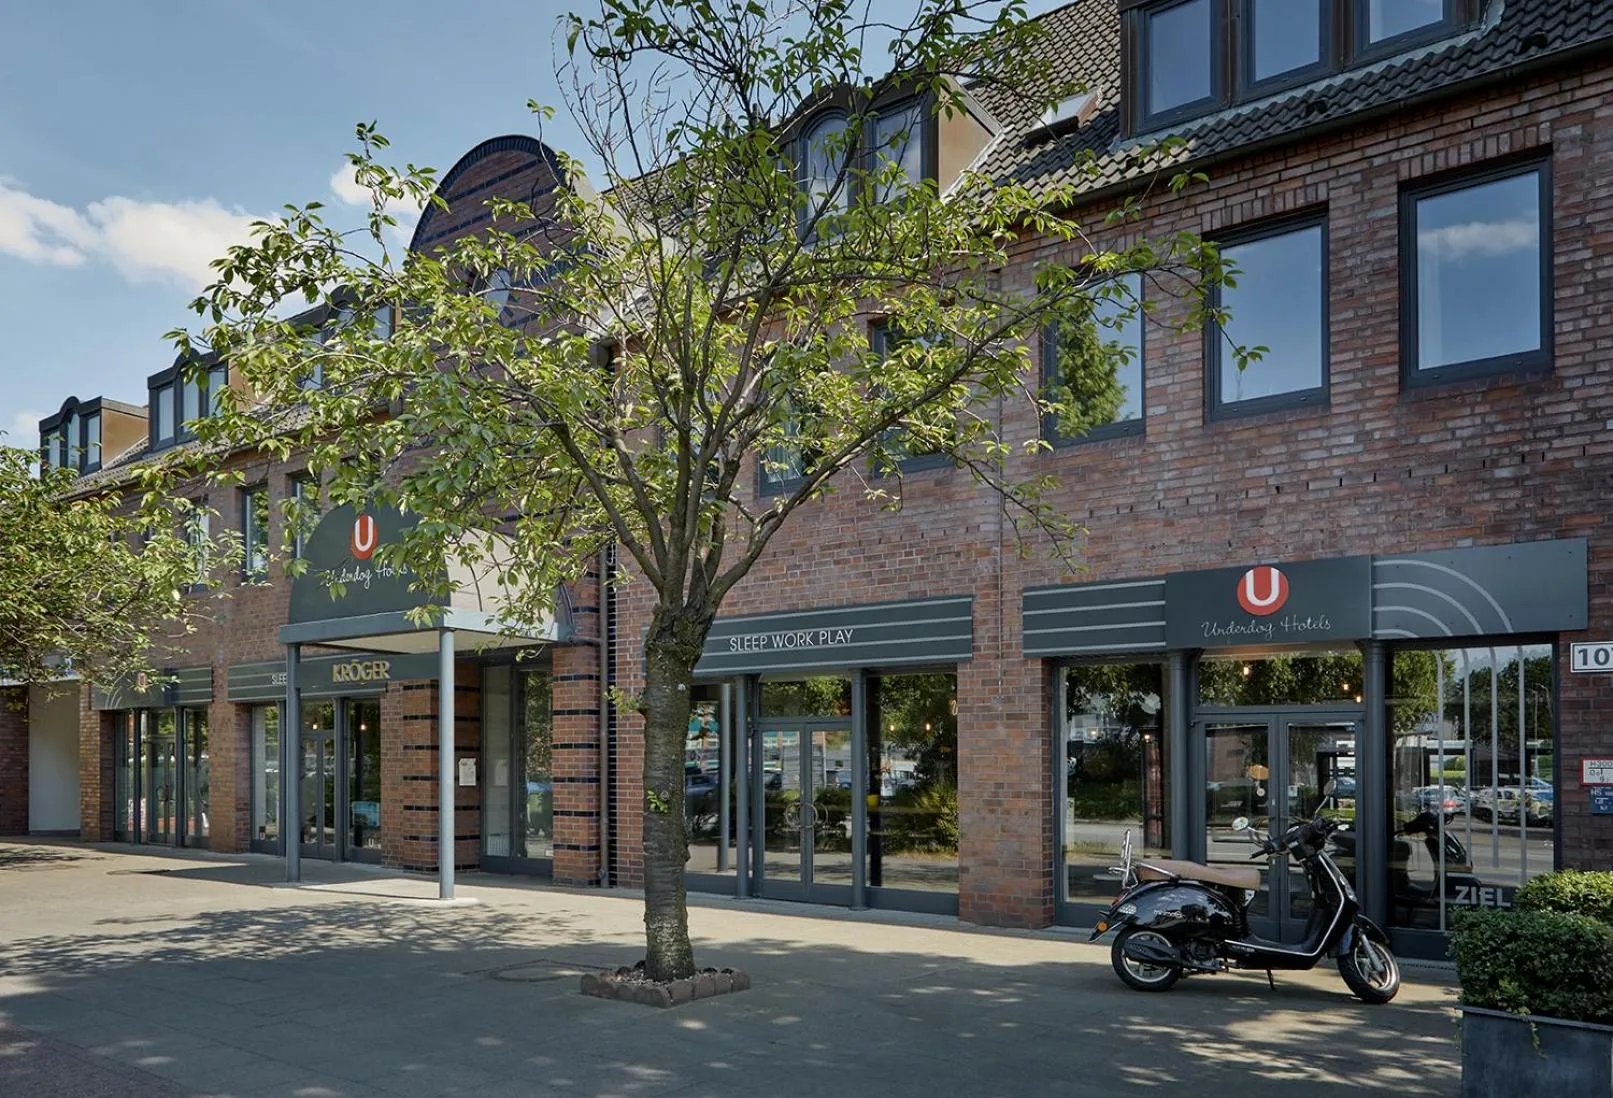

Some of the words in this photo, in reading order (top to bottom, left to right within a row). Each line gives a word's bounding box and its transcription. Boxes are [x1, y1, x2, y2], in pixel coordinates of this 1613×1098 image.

[354, 515, 374, 552] U
[1245, 567, 1280, 607] U
[1201, 619, 1275, 640] Underdog
[1280, 614, 1332, 632] Hotels
[729, 635, 768, 652] SLEEP
[771, 632, 814, 648] WORK
[819, 629, 853, 645] PLAY
[1578, 647, 1613, 667] 10
[1455, 885, 1512, 907] ZIEL
